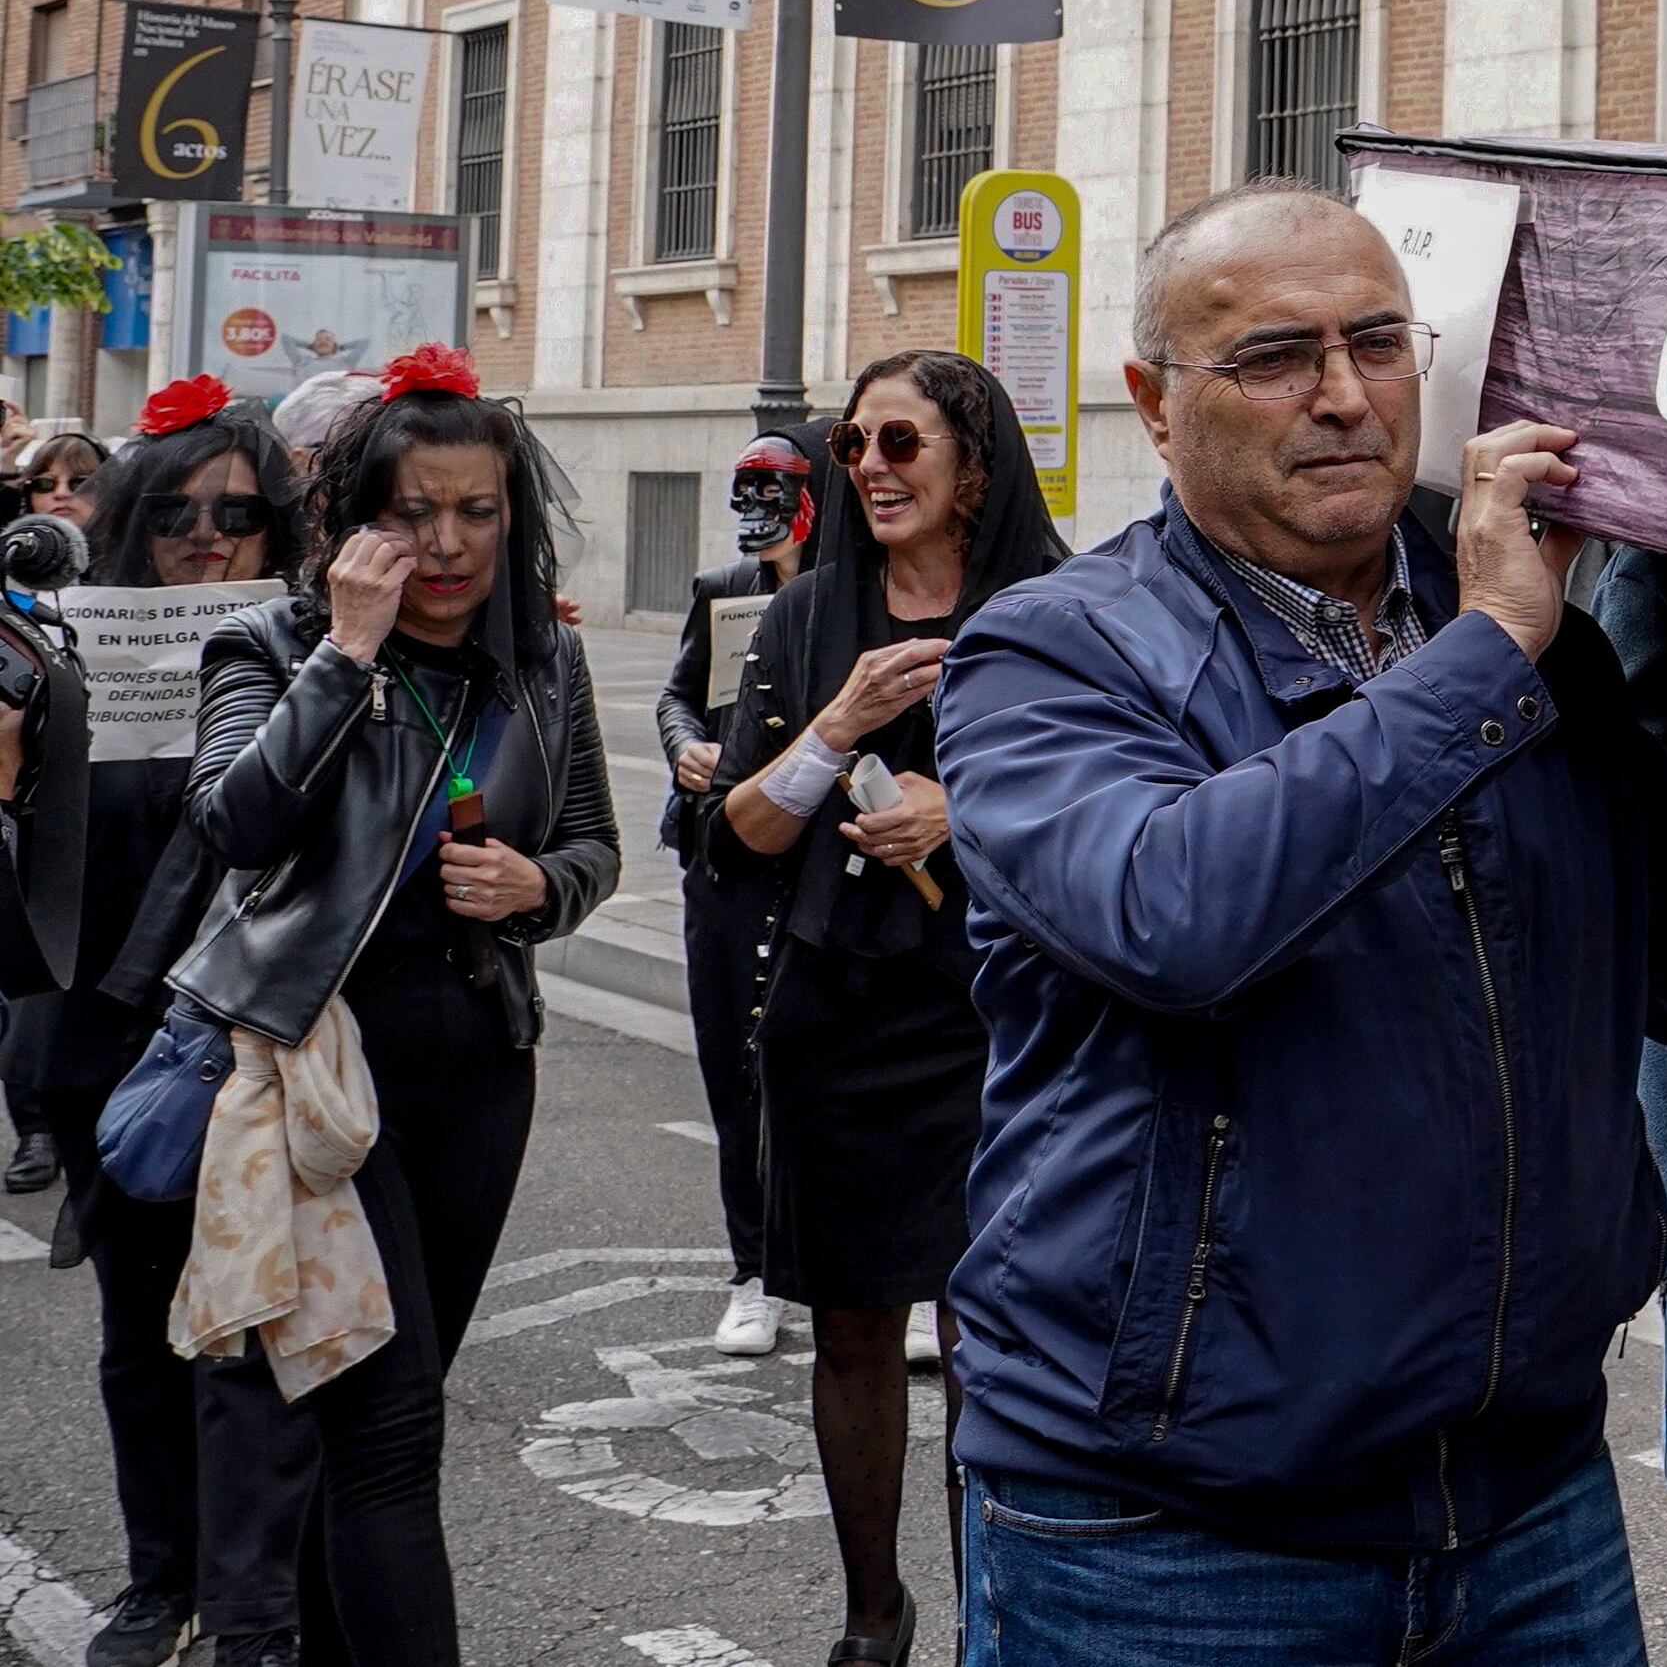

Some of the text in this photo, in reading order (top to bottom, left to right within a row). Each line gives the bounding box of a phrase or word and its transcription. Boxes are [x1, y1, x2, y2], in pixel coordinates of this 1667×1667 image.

[307, 57, 415, 104] ÉRASE
[139, 45, 227, 181] 6
[305, 98, 349, 122] UNA
[173, 143, 228, 160] actos
[1013, 211, 1043, 230] BUS
[1399, 227, 1433, 260] R.I.P.
[63, 607, 157, 622] CIONARI@S
[164, 606, 186, 617] DE
[98, 632, 201, 645] EN HUELGA
[108, 686, 196, 701] DEFINIDAS
